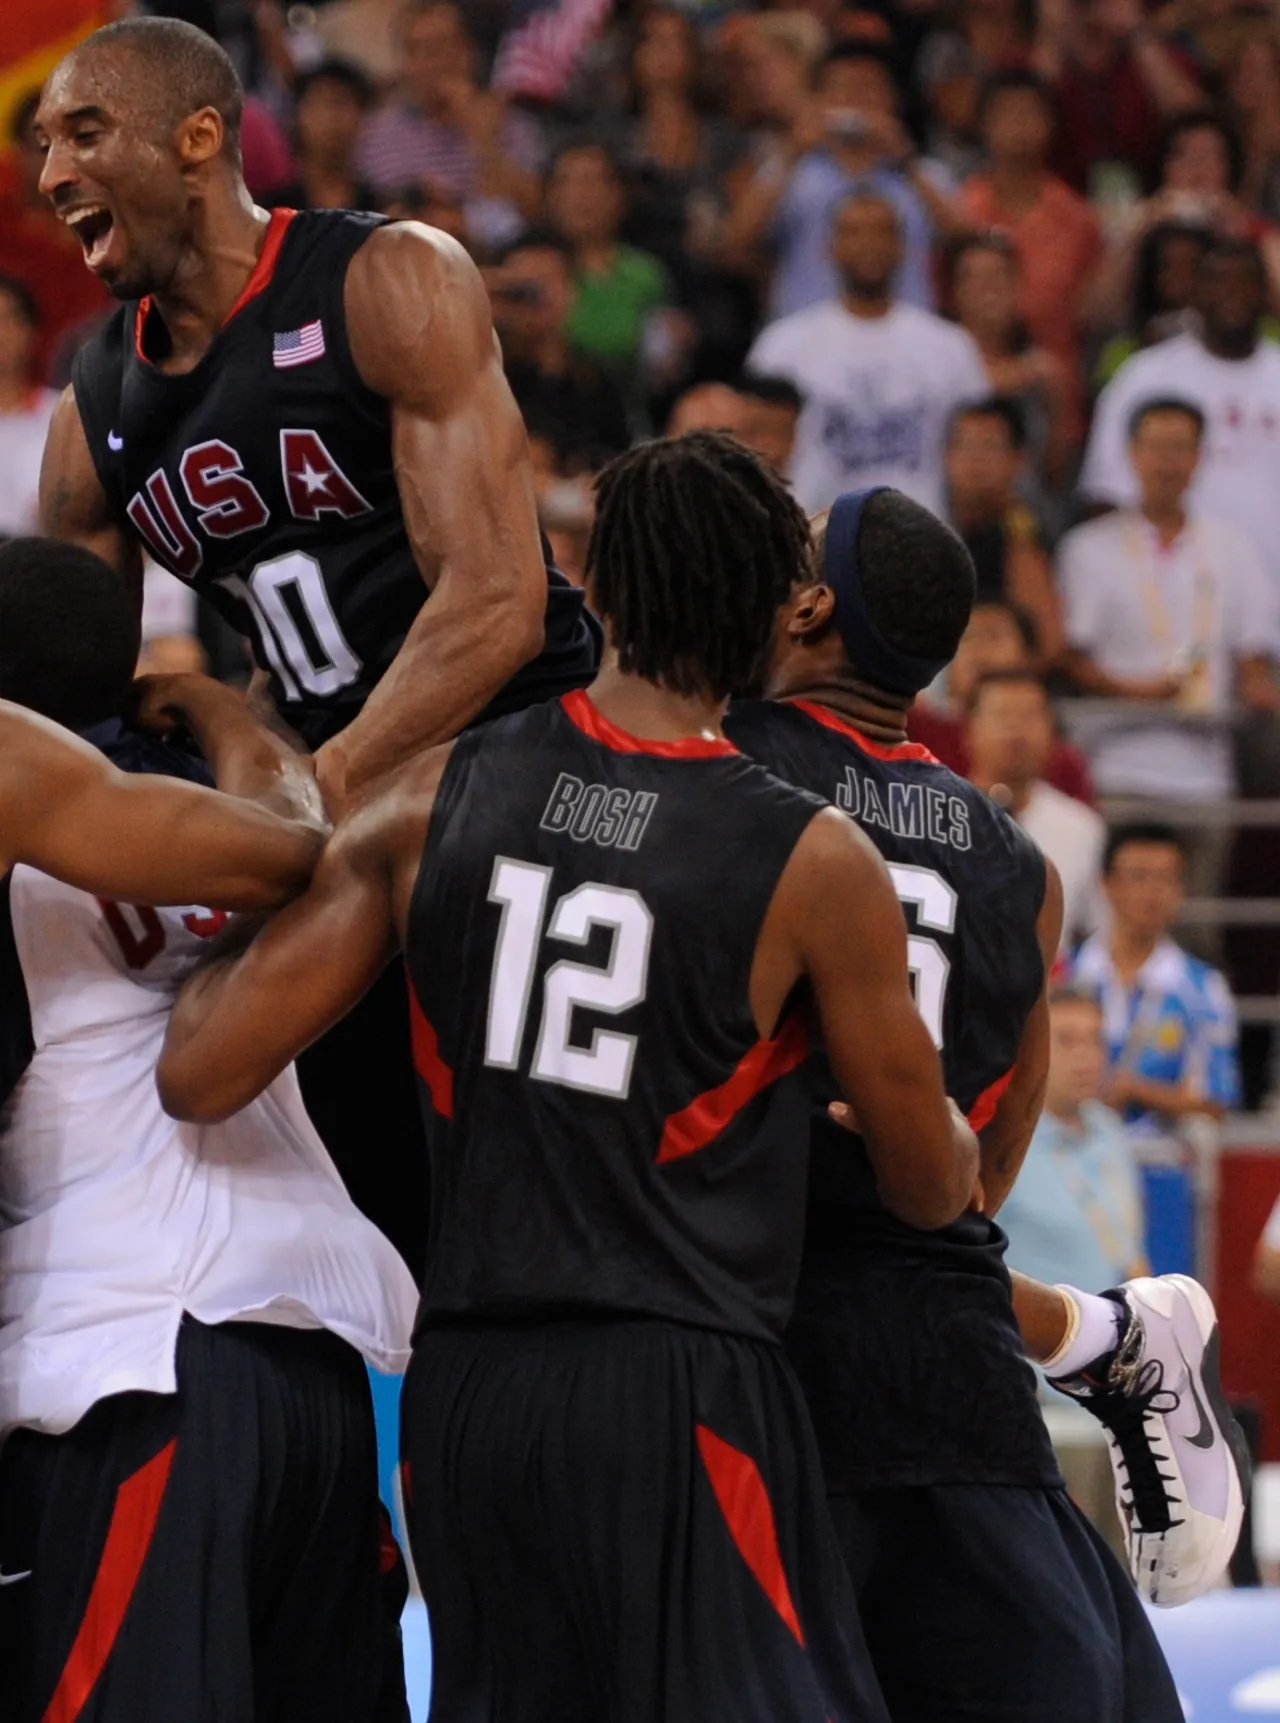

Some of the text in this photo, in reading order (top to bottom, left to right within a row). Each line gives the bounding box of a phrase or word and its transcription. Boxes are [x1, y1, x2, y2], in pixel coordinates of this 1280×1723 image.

[126, 428, 375, 578] USA
[212, 550, 363, 701] 10
[539, 772, 659, 851] BOSH
[836, 766, 971, 851] JAMES
[484, 855, 654, 1099] 12
[886, 861, 958, 1051] 6
